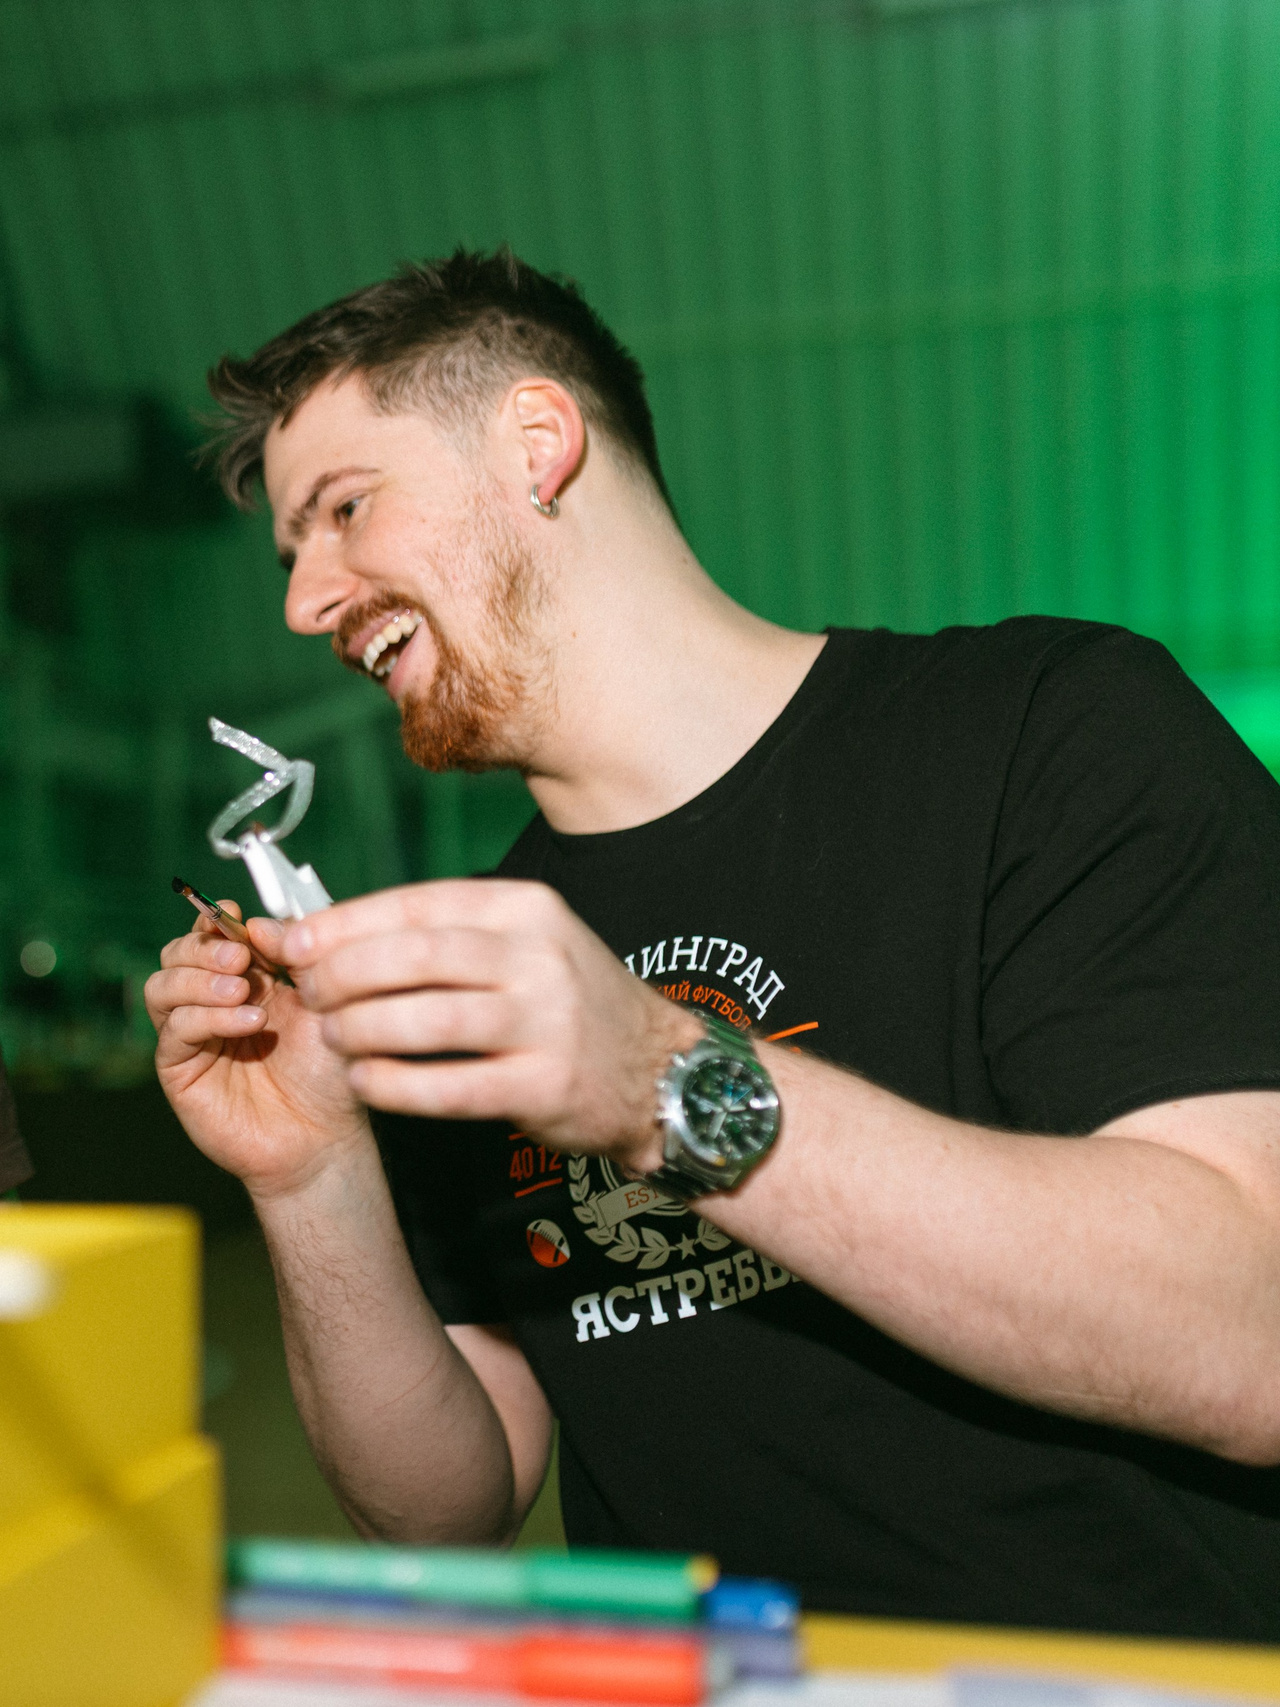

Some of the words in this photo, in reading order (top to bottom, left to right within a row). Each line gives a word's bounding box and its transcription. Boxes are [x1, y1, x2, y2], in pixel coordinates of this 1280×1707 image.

[657, 979, 691, 1001] ИЙ
[692, 984, 752, 1032] ФУТБОЛ
[509, 1144, 563, 1182] 4012
